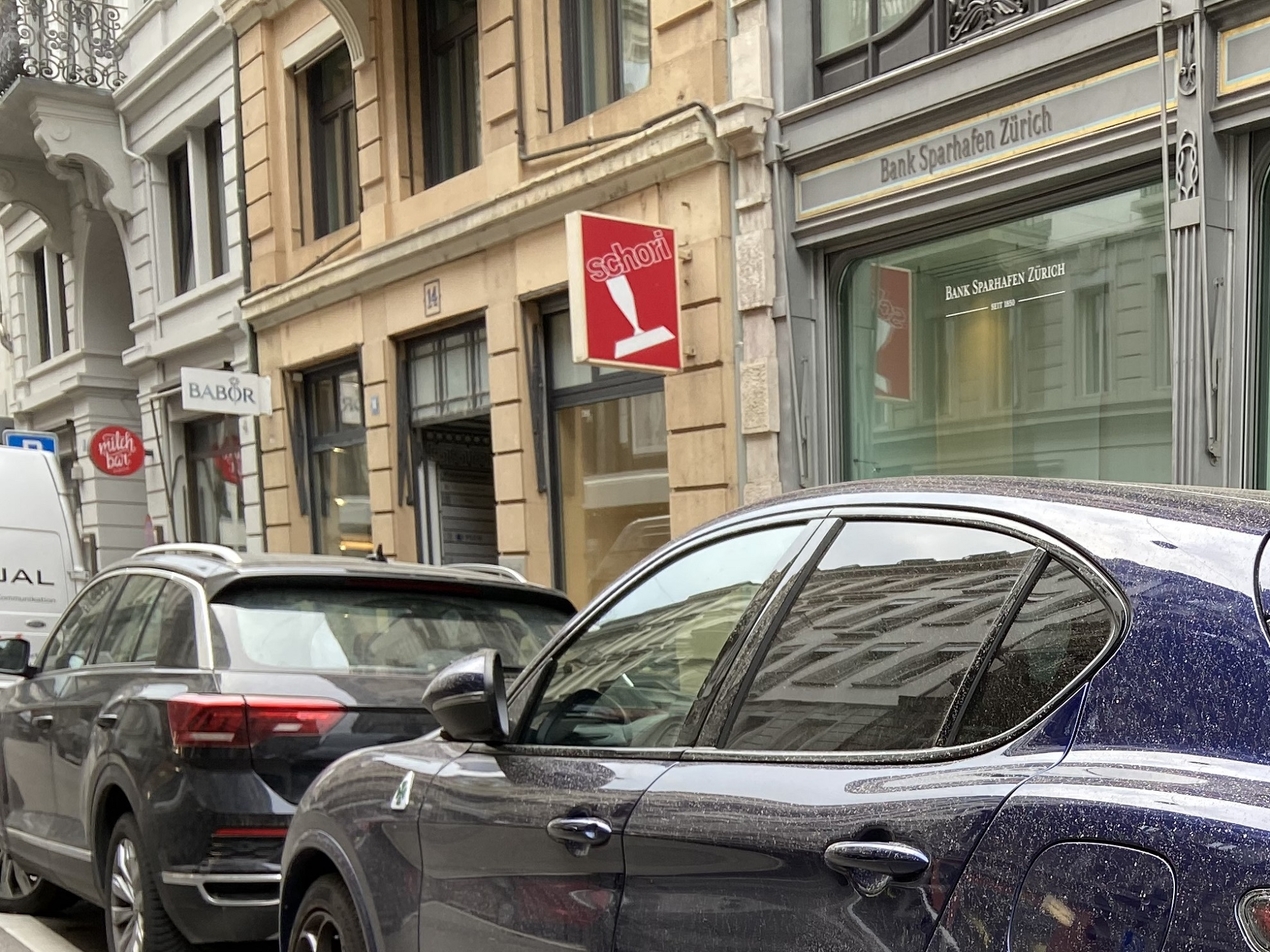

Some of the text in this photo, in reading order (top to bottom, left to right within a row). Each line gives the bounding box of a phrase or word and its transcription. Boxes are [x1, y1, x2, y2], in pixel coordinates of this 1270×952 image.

[880, 104, 1053, 184] Bank Sparhafen Zürich
[586, 229, 673, 283] schori
[945, 262, 1066, 301] BANK SPARHAFEN ZÜRICH
[426, 285, 439, 310] 14
[188, 380, 257, 405] BABOR
[98, 430, 137, 455] milch
[105, 451, 132, 470] bar
